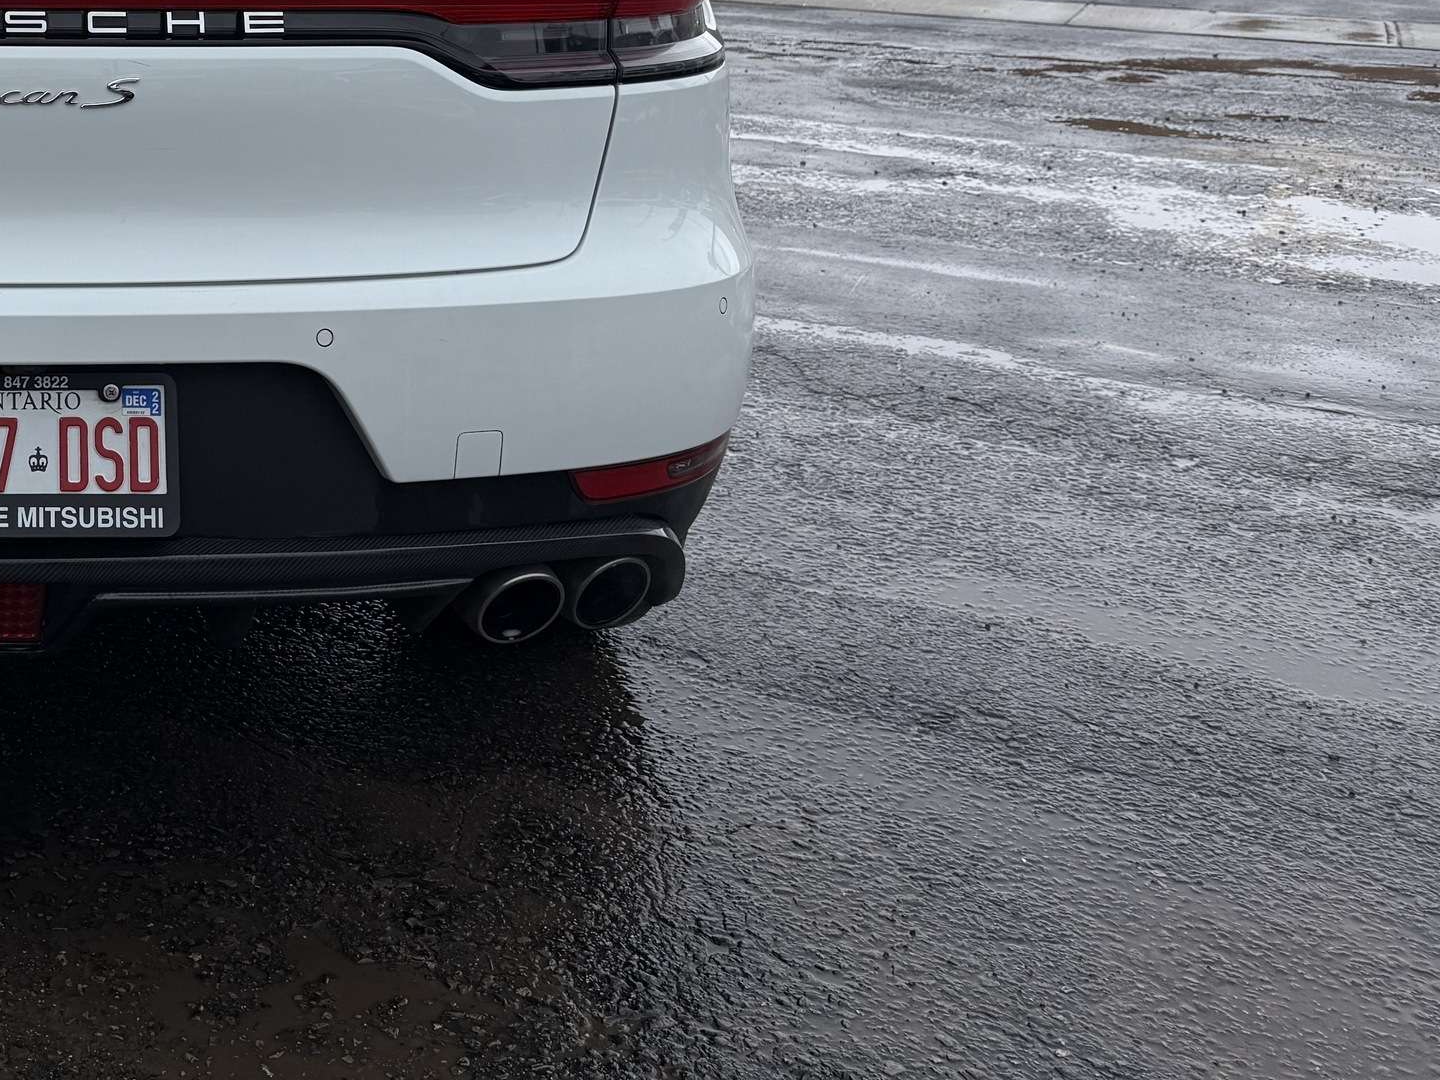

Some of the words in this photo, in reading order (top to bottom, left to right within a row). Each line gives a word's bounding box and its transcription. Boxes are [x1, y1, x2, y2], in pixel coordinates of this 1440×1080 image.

[80, 77, 141, 109] S
[3, 375, 30, 389] 847
[33, 375, 69, 389] 3822
[125, 394, 148, 407] DEC
[59, 417, 160, 493] DSD
[17, 506, 164, 528] MITSUBISHI
